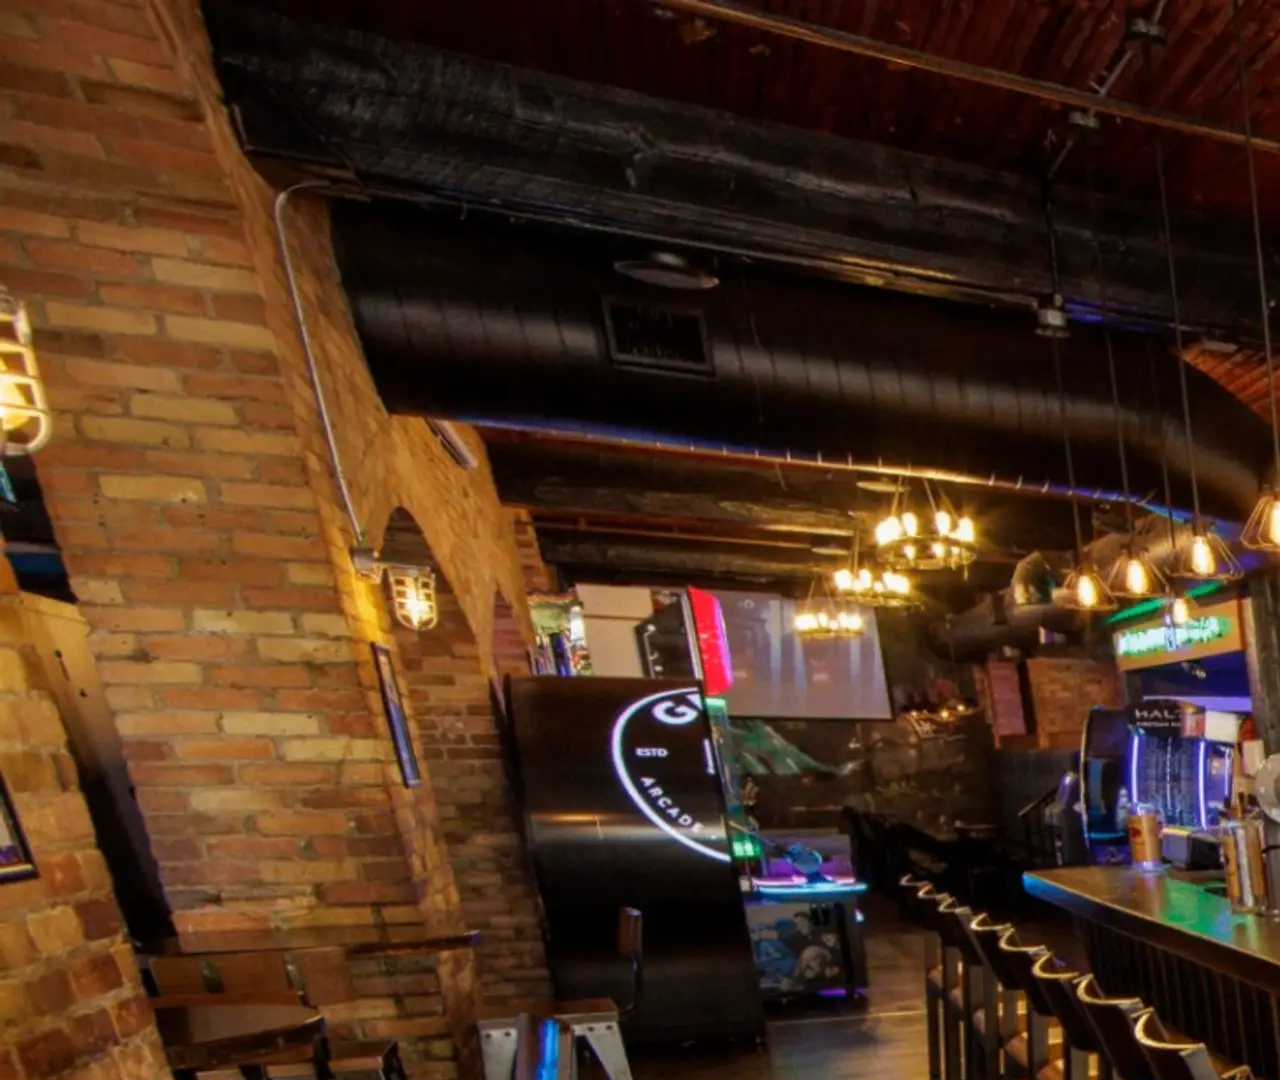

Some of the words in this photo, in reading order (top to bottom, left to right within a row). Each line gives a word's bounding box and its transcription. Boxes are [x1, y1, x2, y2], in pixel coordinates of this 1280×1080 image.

[1134, 707, 1182, 720] HAL
[634, 747, 669, 758] ESTD
[640, 776, 705, 834] ARCADE
